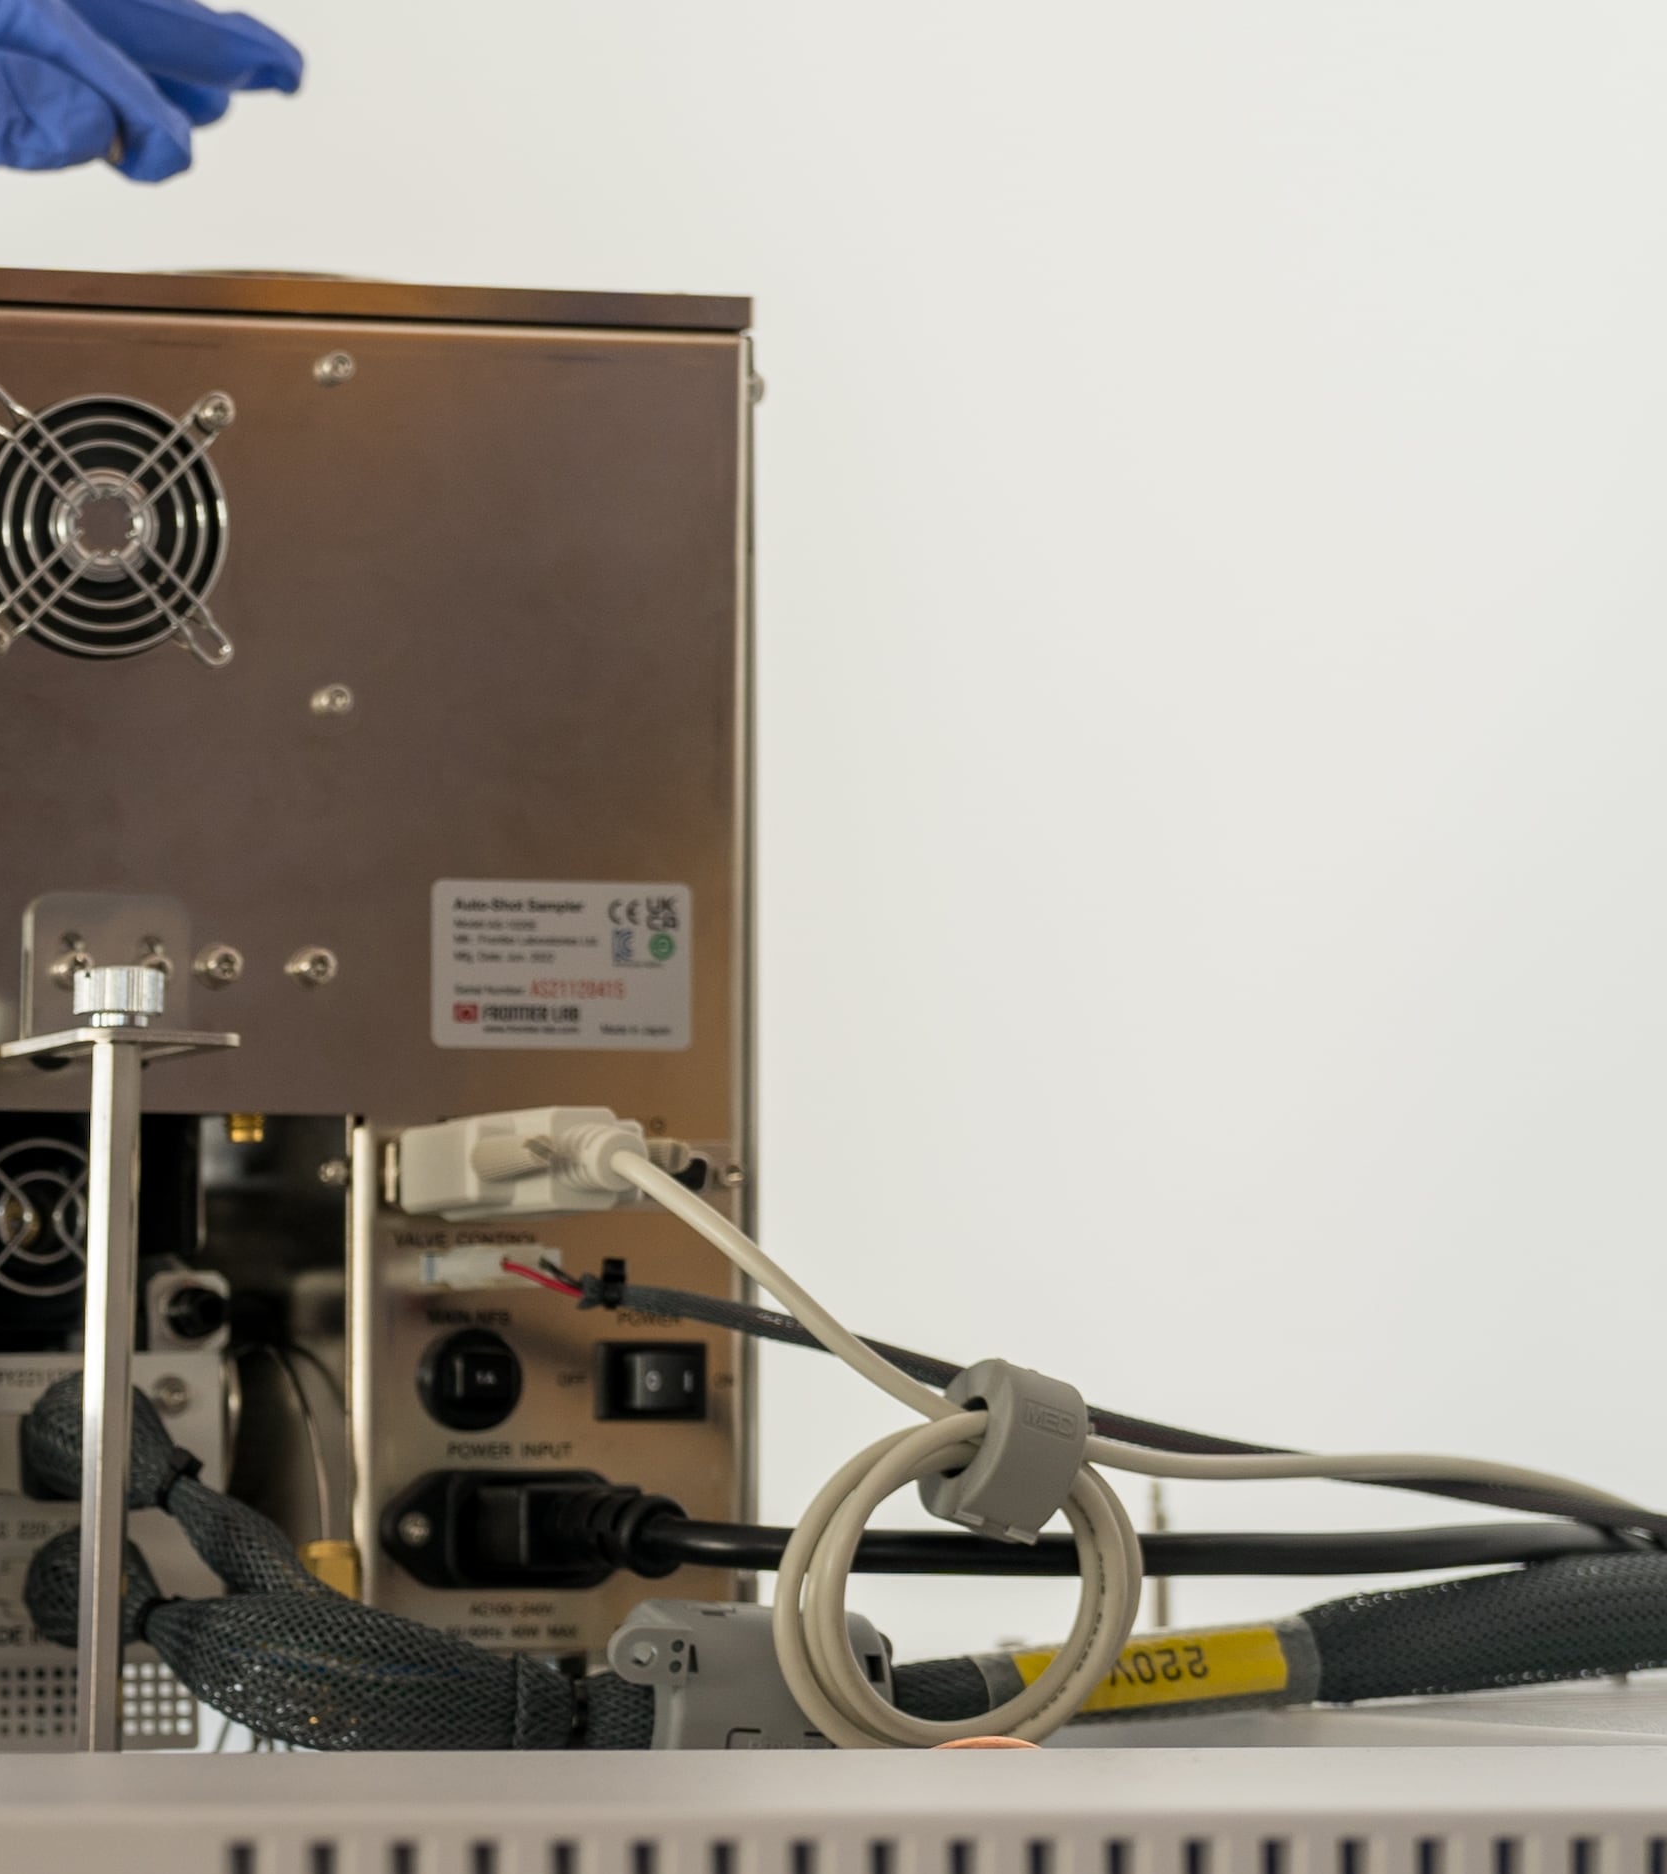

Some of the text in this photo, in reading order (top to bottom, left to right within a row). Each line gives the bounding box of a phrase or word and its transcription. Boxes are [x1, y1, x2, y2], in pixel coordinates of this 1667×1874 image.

[482, 1003, 549, 1023] FRONTIER
[394, 1231, 446, 1248] VALVE
[446, 1441, 572, 1459] POWER INPUT
